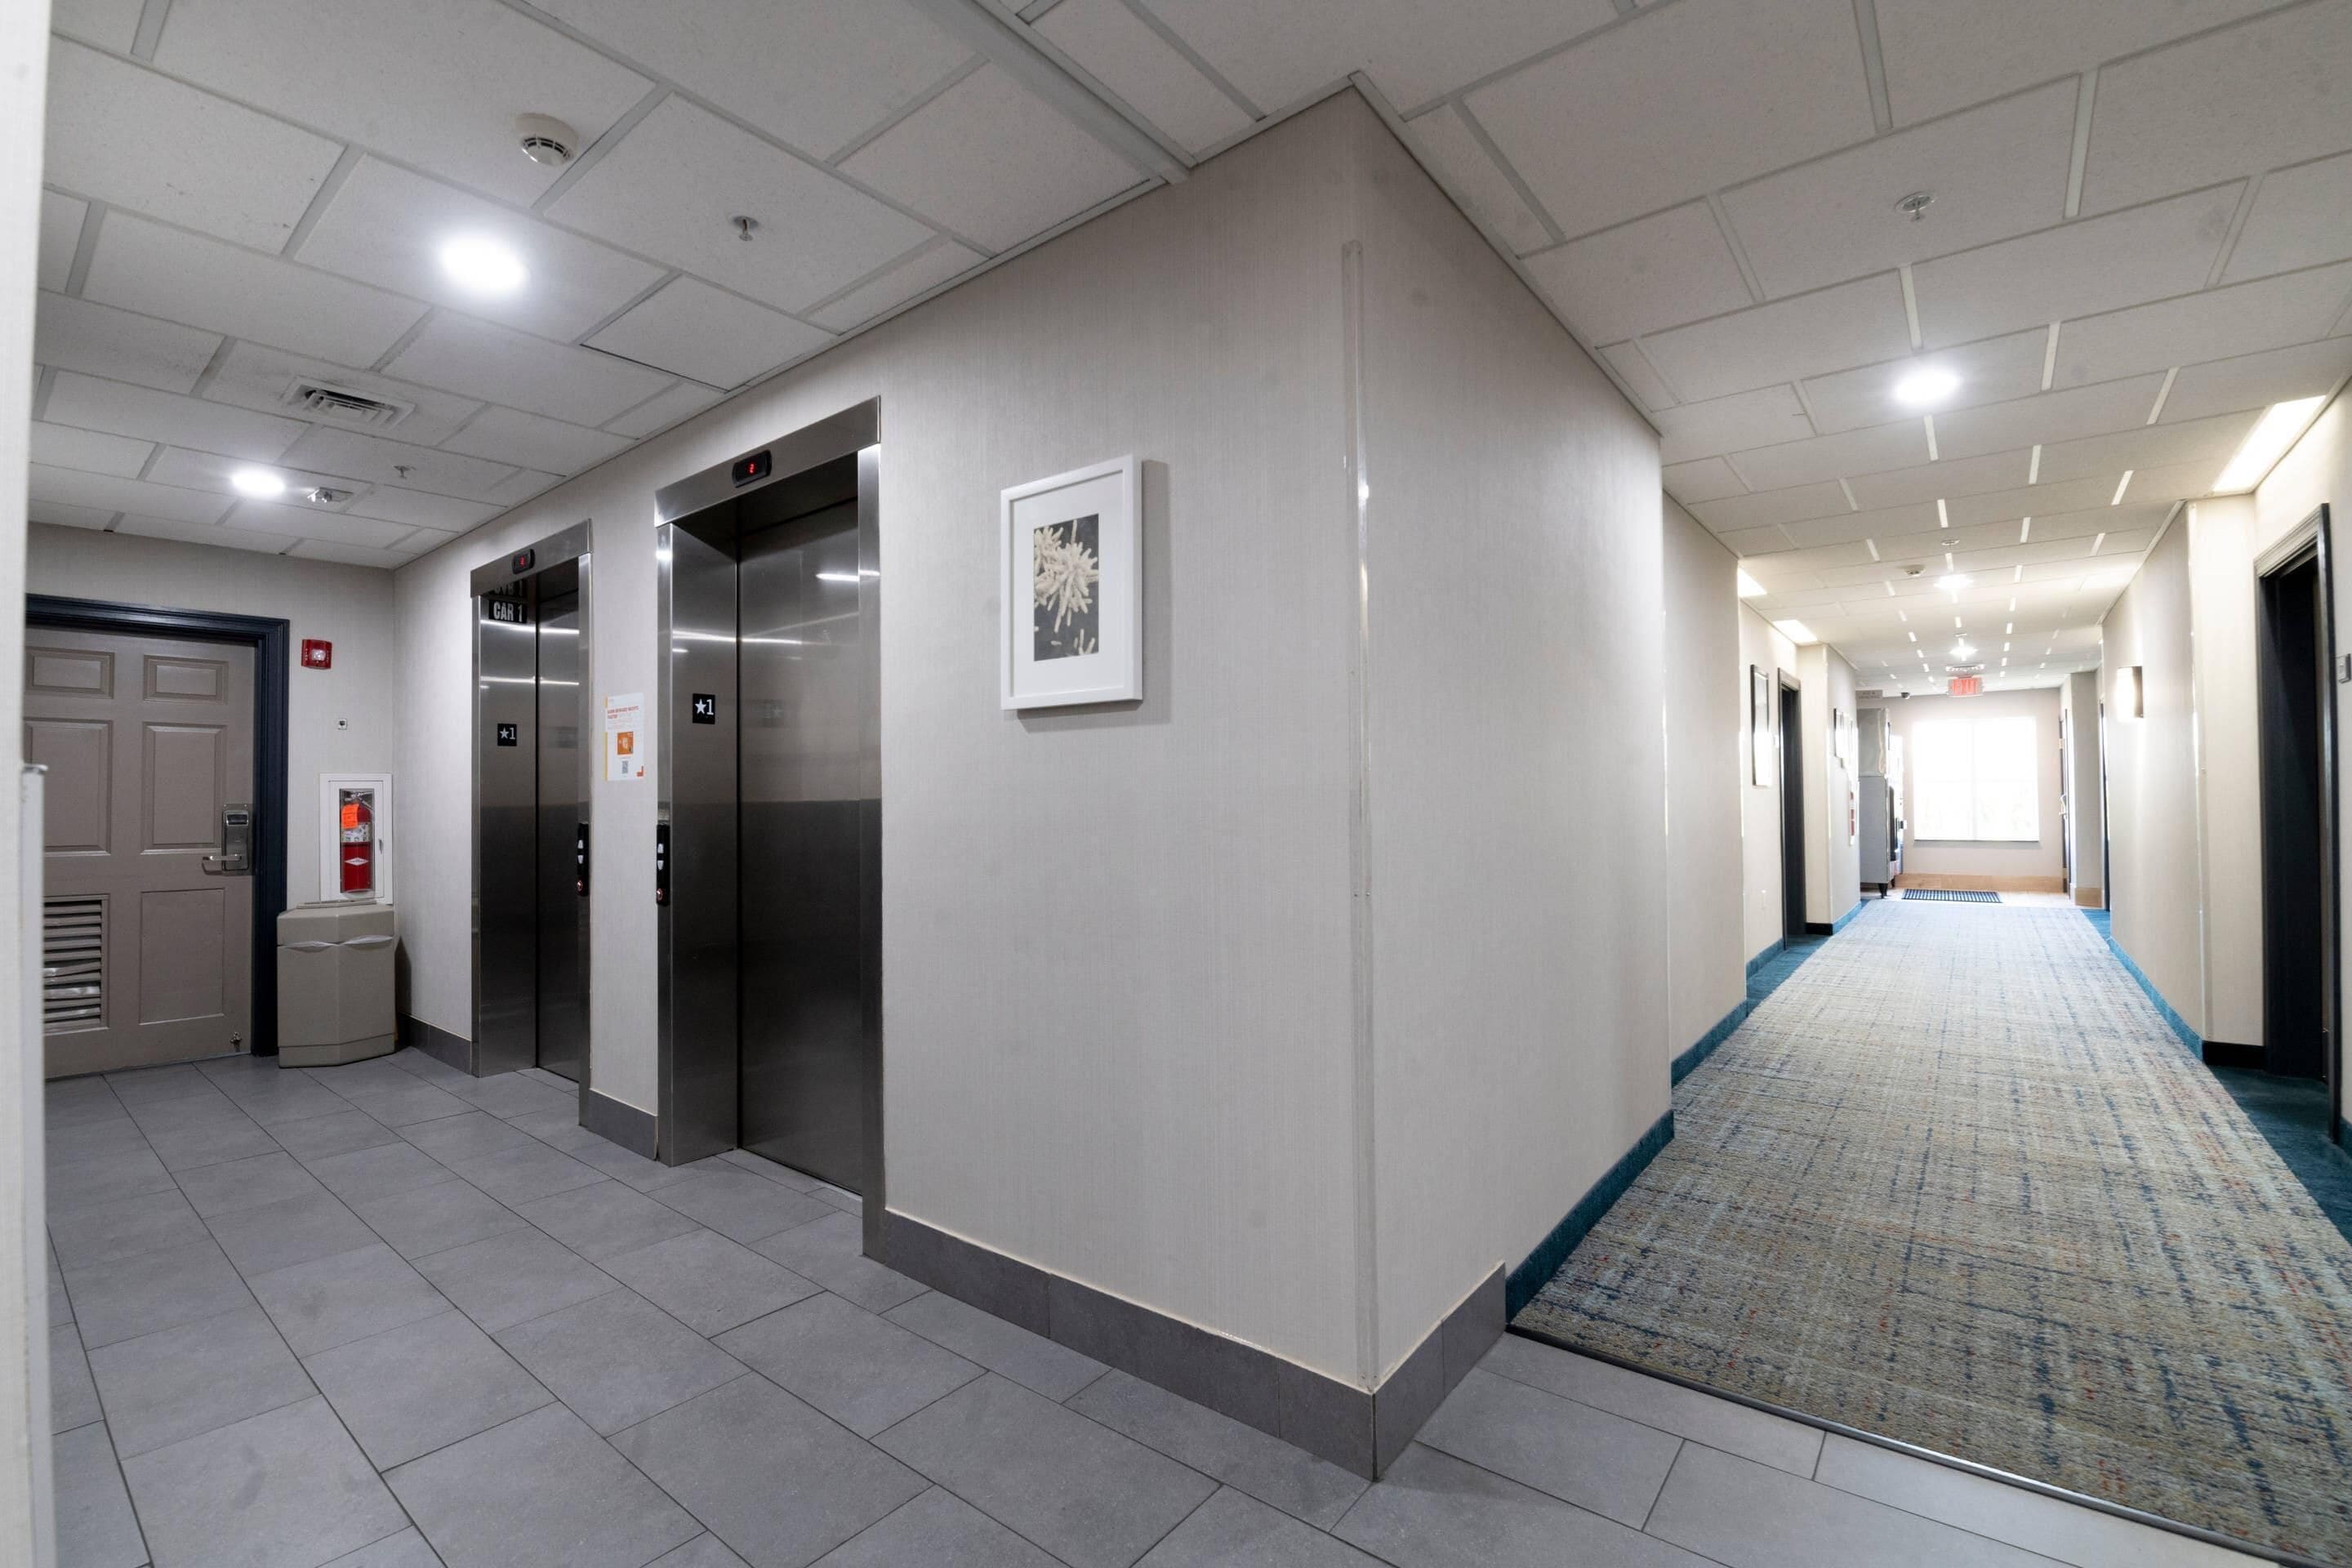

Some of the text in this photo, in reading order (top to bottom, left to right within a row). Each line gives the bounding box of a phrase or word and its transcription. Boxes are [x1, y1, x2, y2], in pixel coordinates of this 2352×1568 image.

[493, 601, 523, 622] CAR 1
[1953, 679, 1979, 694] EXIT
[706, 698, 715, 715] 1
[509, 727, 516, 740] 1
